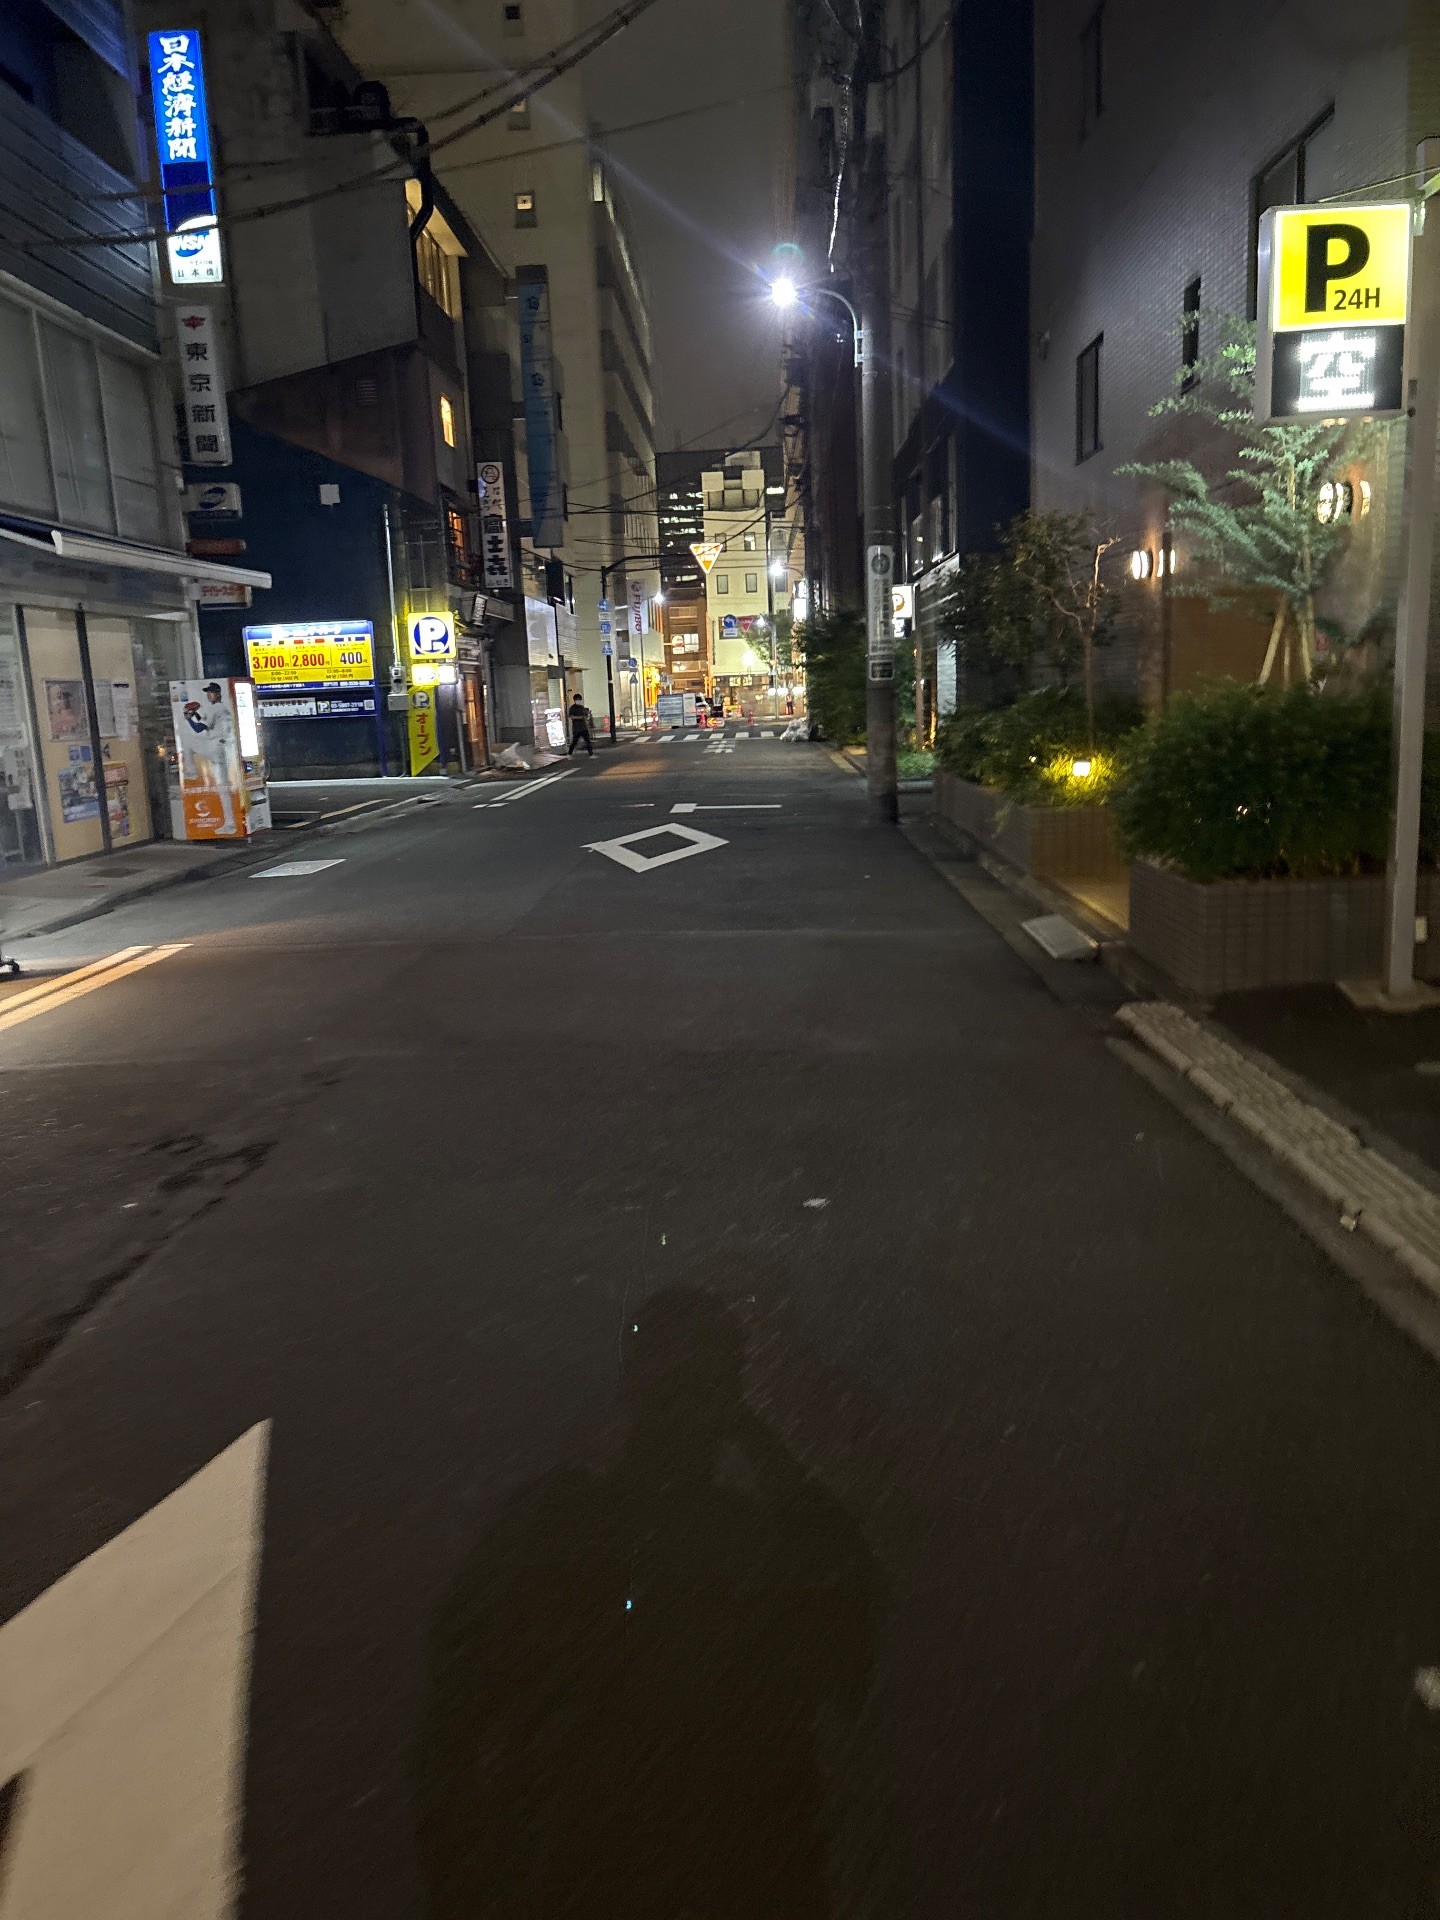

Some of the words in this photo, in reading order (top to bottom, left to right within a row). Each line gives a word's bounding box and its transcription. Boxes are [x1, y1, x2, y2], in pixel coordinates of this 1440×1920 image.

[1304, 223, 1371, 313] P
[1333, 287, 1381, 311] 24H
[184, 342, 219, 453] 東京新聞
[1298, 331, 1376, 413] 空
[416, 712, 431, 756] オープン
